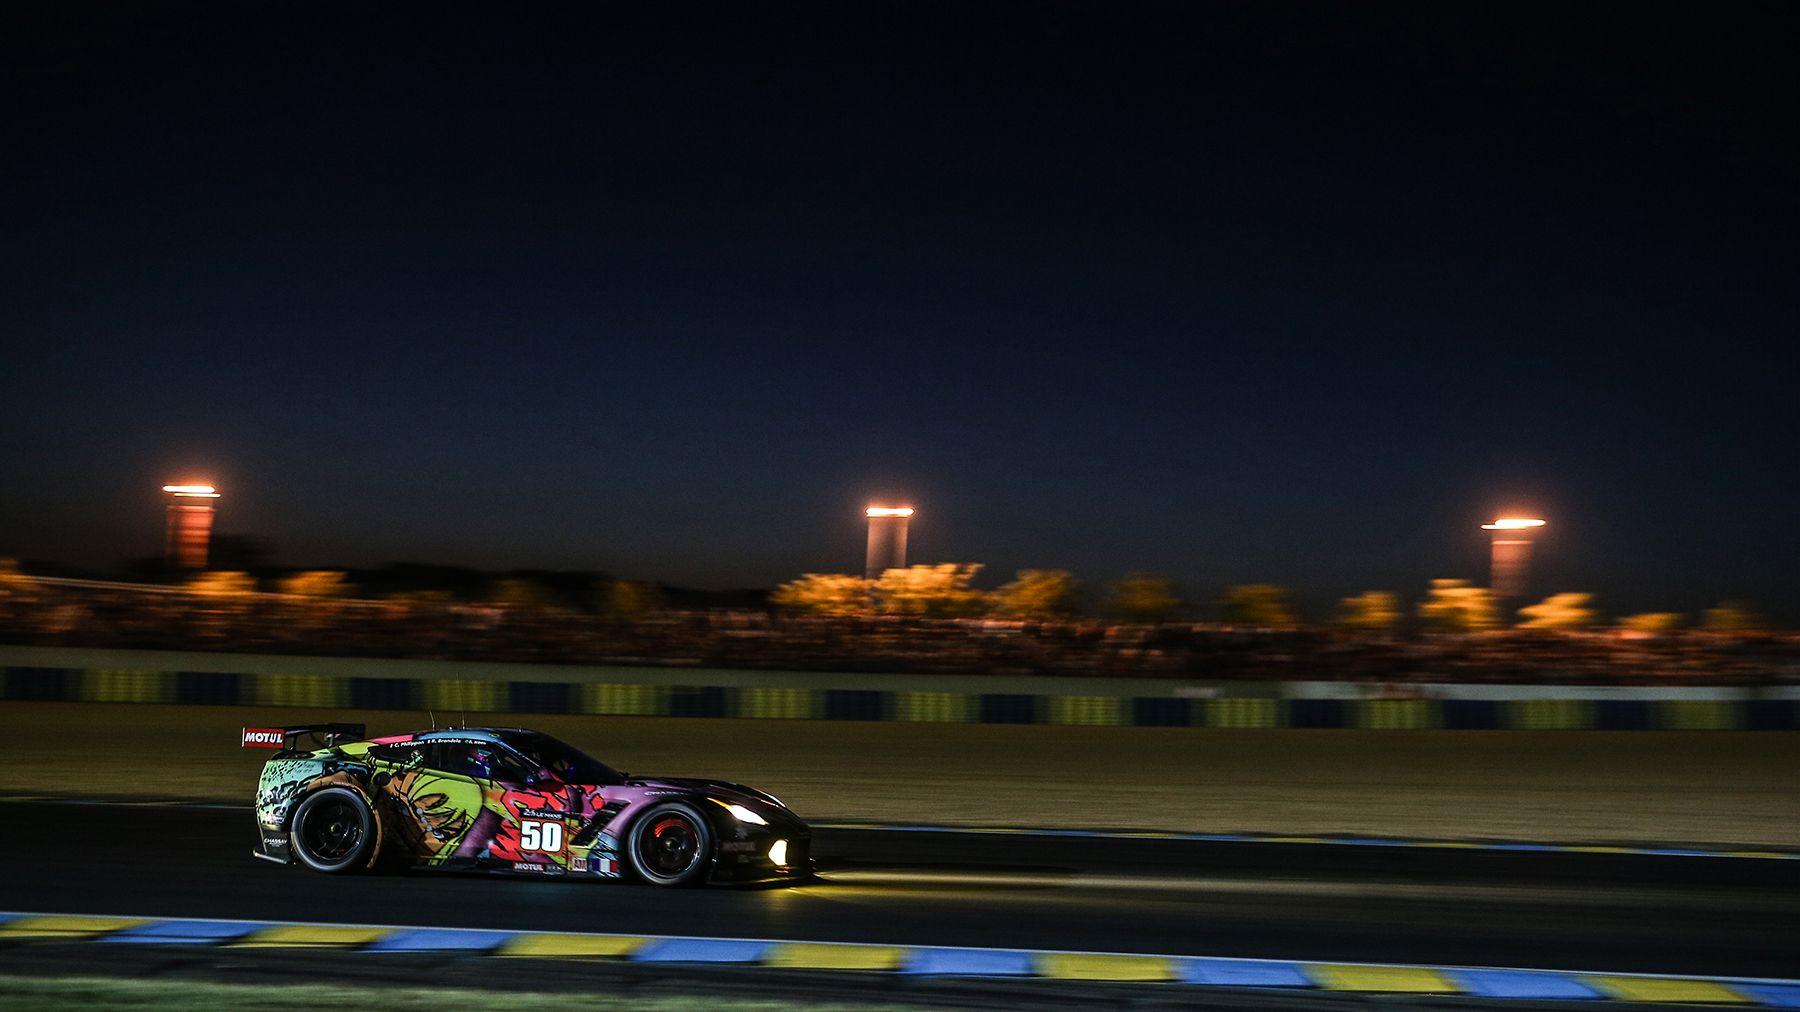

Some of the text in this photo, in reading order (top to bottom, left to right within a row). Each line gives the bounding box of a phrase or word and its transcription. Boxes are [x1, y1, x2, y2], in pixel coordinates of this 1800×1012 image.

[244, 732, 283, 743] MOTUL
[520, 820, 563, 853] 50
[513, 862, 544, 872] MOTUL
